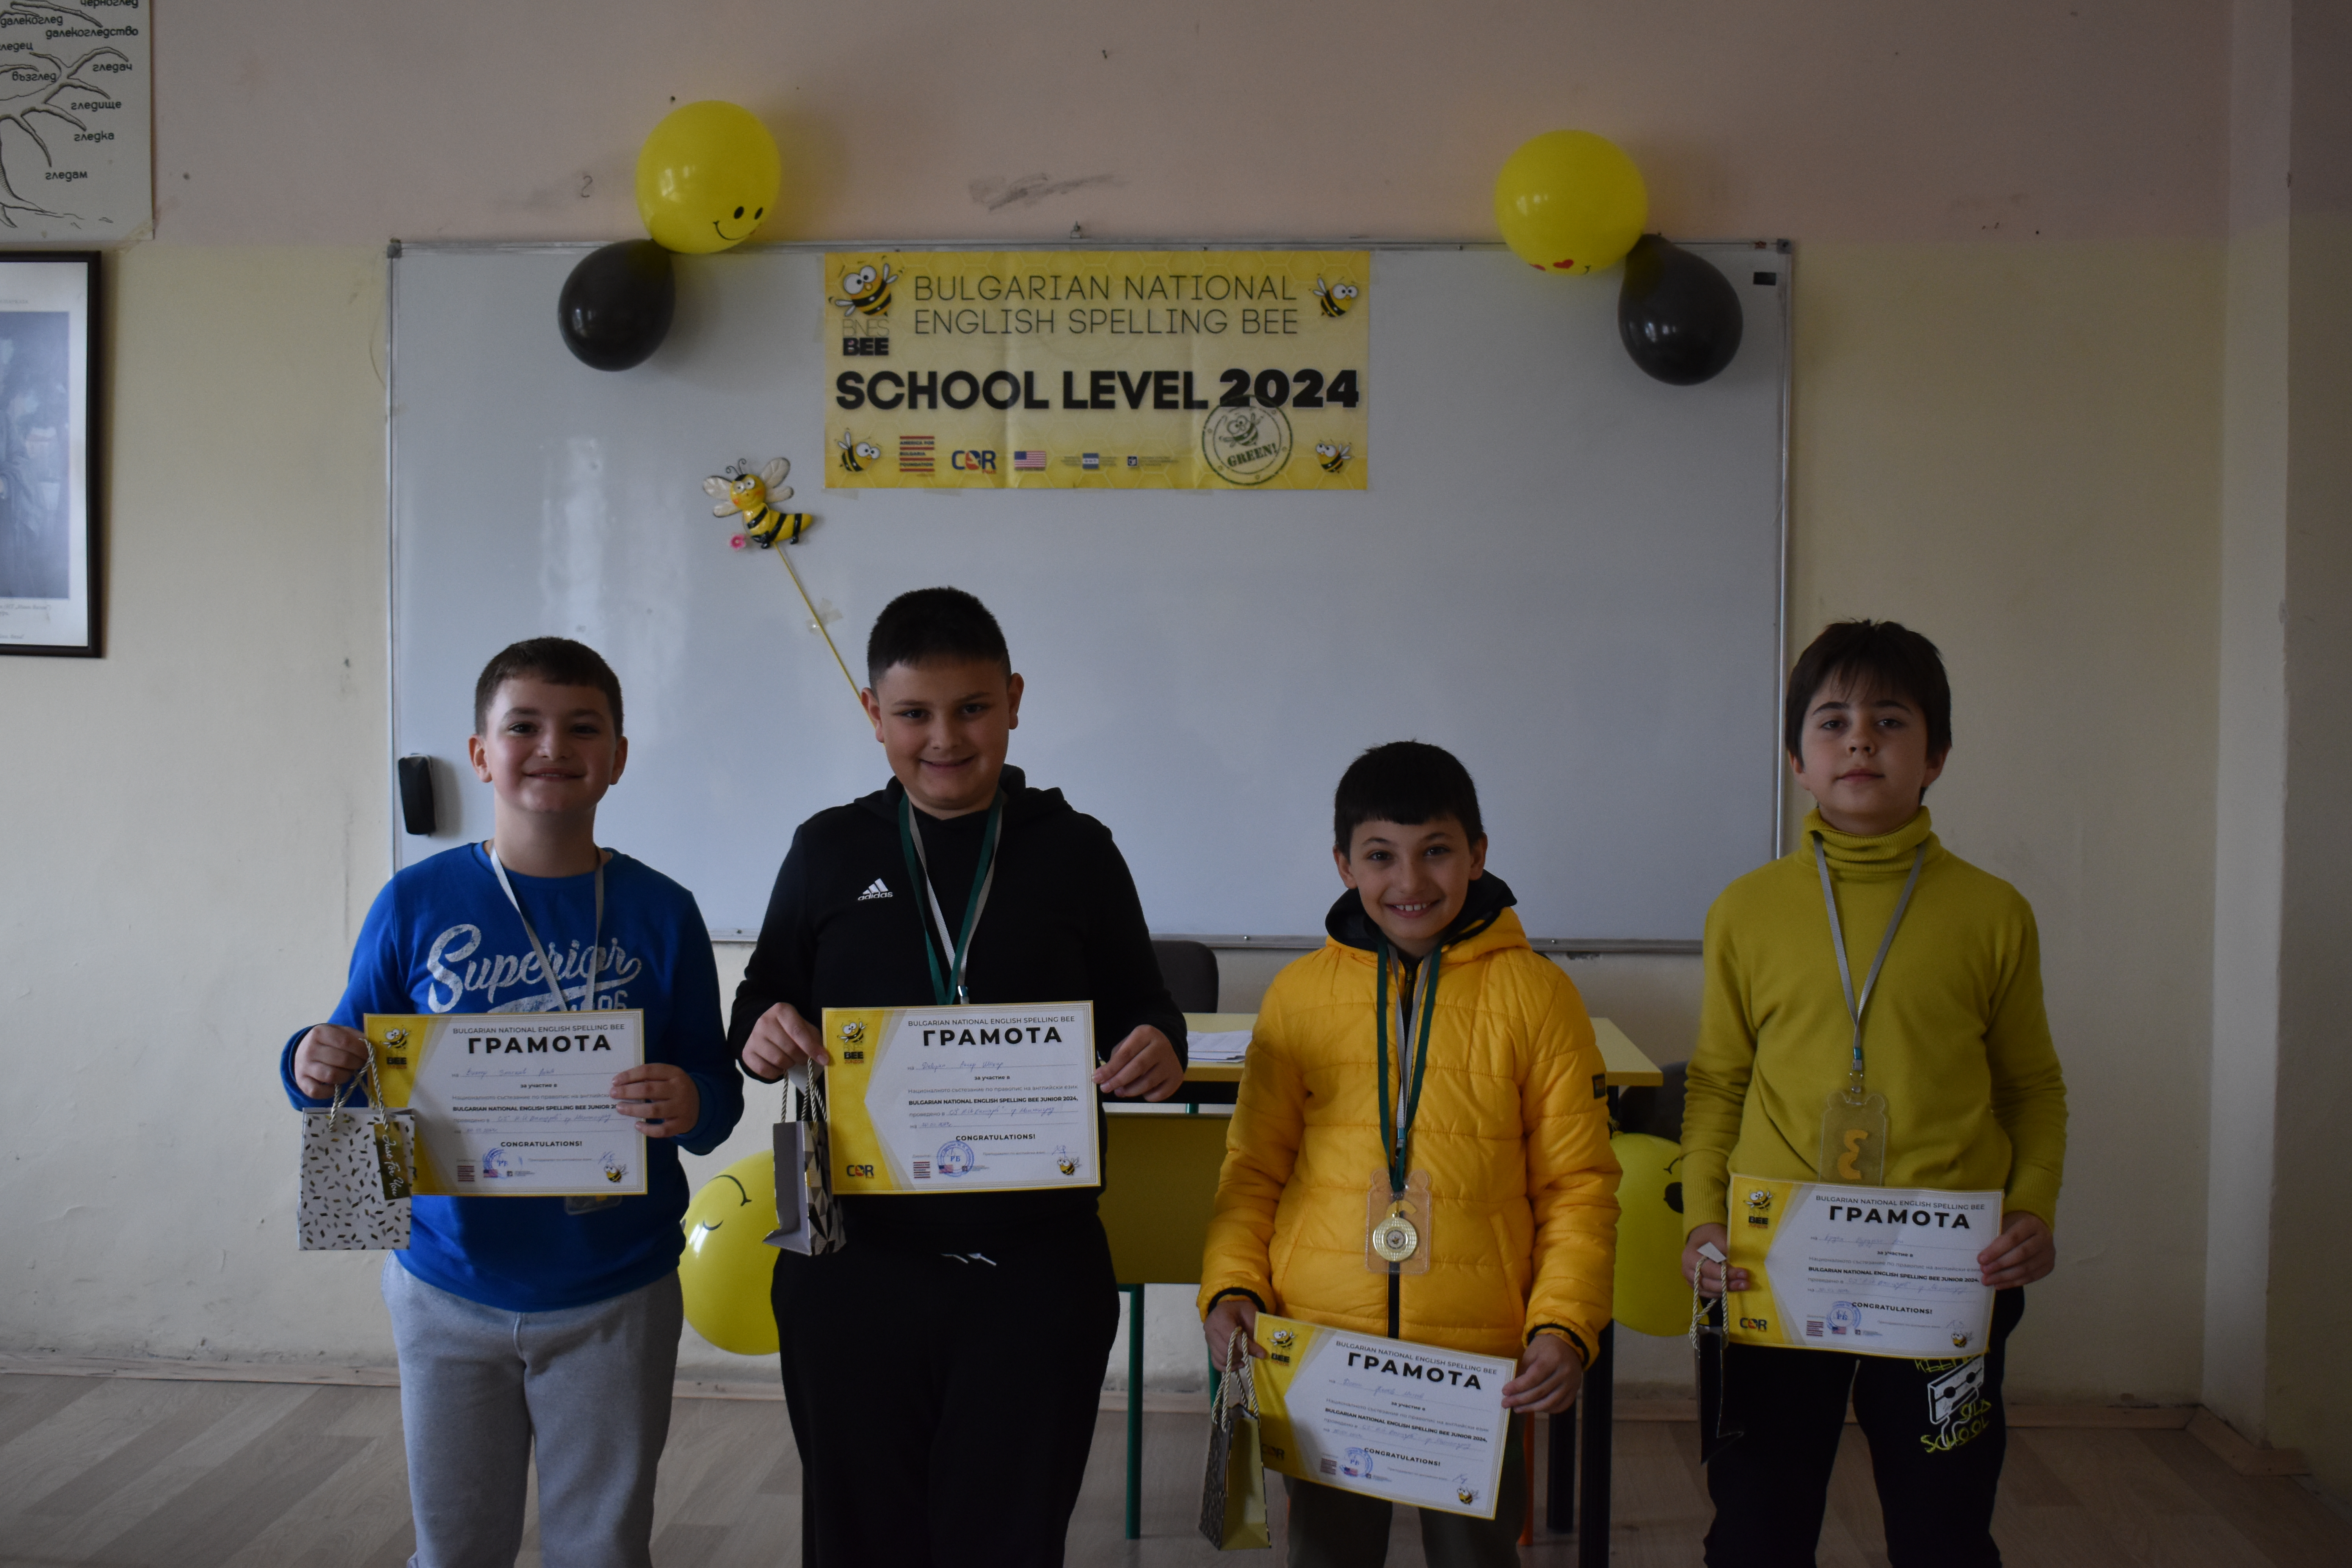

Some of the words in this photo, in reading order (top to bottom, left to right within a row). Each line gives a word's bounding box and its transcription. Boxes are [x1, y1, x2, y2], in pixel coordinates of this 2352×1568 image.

[1, 15, 63, 28] далекоглед
[46, 26, 138, 39] далекогледство
[0, 43, 33, 52] ледец
[12, 71, 56, 82] възглед
[93, 64, 132, 73] гледач
[71, 101, 122, 111] гледище
[74, 131, 114, 142] гледка
[45, 171, 87, 181] гледам
[915, 275, 1109, 300] BULGARIAN
[1126, 275, 1297, 300] NATIONAL
[915, 309, 1053, 334] ENGLISH
[1069, 309, 1227, 334] SPELLING
[1243, 309, 1297, 334] BEE
[843, 338, 889, 356] BEE
[836, 370, 1049, 410] SCHOOL
[1063, 370, 1209, 409] LEVEL
[1220, 368, 1359, 408] 2024
[1227, 443, 1278, 467] GREEN!
[858, 891, 893, 901] adidas
[468, 1034, 612, 1054] ГРАМОТА
[923, 1026, 1062, 1046] ГРАМОТА
[1816, 1195, 1858, 1203] BULGARIAN
[1829, 1205, 1970, 1229] ГРАМОТА
[1852, 1301, 1933, 1315] CONGRATULATIONS!
[1336, 1340, 1376, 1353] BULGARIAN
[1378, 1349, 1413, 1360] NATIONAL
[1415, 1356, 1446, 1366] ENGLISH
[1447, 1361, 1481, 1372] SPELLING
[1348, 1352, 1481, 1390] ГРАМОТА
[1325, 1407, 1357, 1418] BULGARIAN
[1358, 1414, 1386, 1425] NATIONAL
[1387, 1420, 1410, 1429] ENGLISH
[1411, 1425, 1438, 1434] SPELLING
[1451, 1432, 1472, 1440] JUNIOR
[1364, 1447, 1441, 1466] CONGRATULATIONS!
